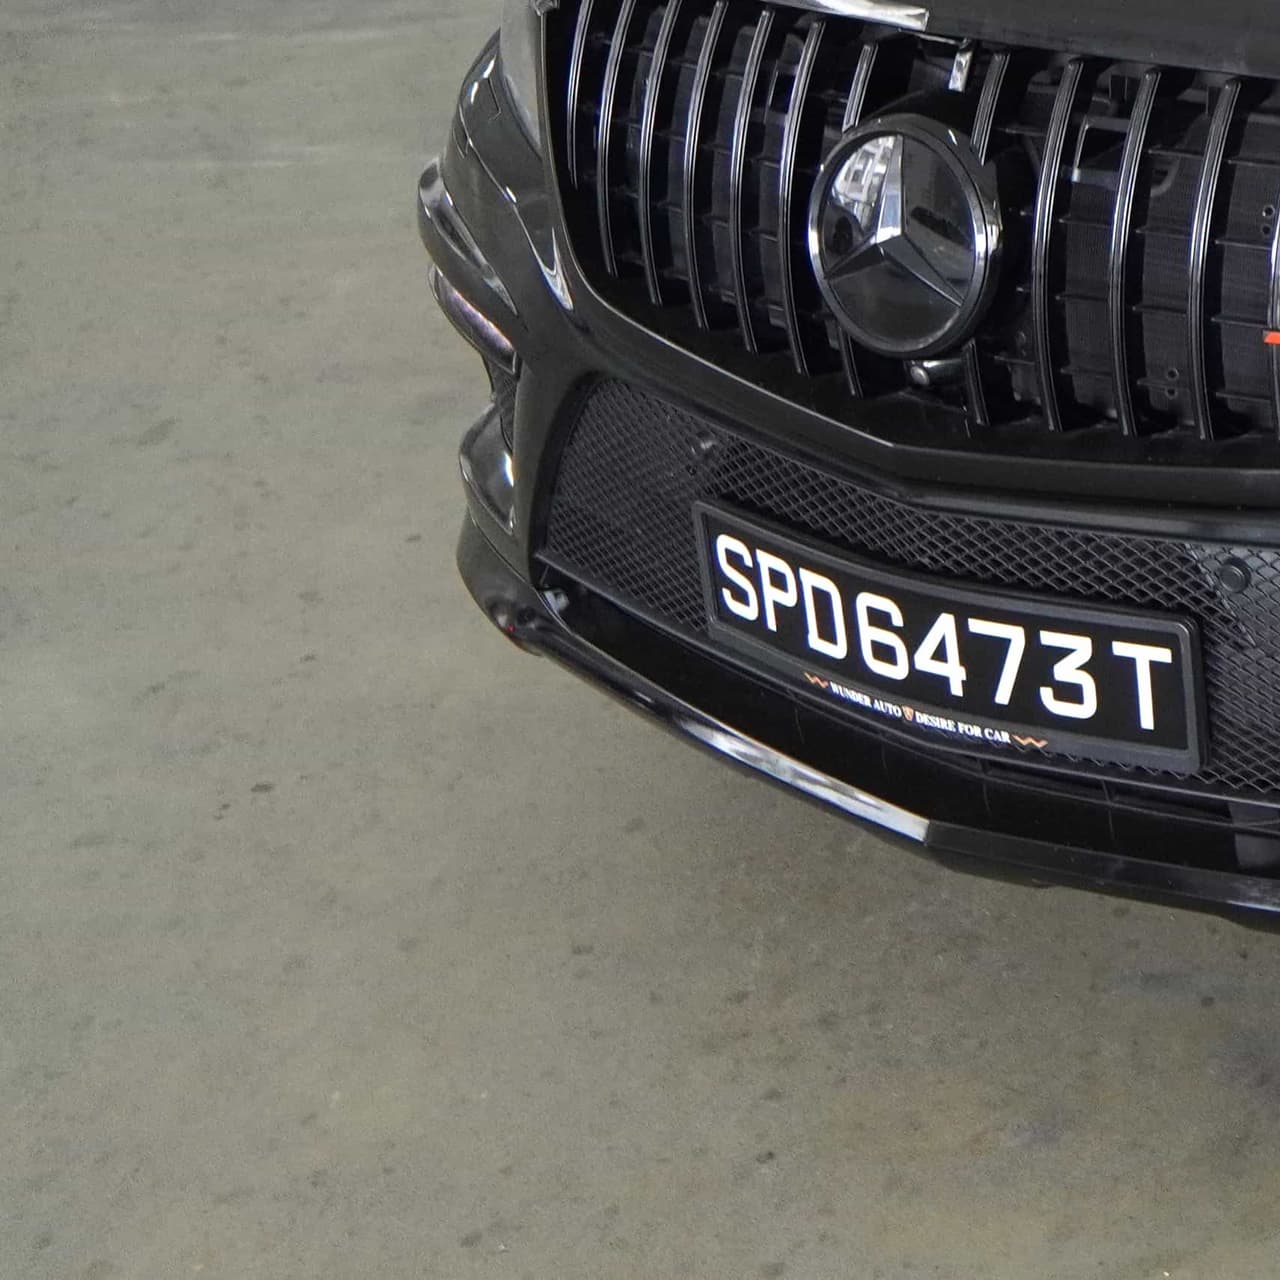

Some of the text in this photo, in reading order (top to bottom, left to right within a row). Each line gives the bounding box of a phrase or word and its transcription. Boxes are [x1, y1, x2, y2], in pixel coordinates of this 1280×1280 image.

[715, 533, 1172, 730] SPD6473T
[829, 681, 1012, 744] WUNDER AUTO DESIRE FOR CAR
